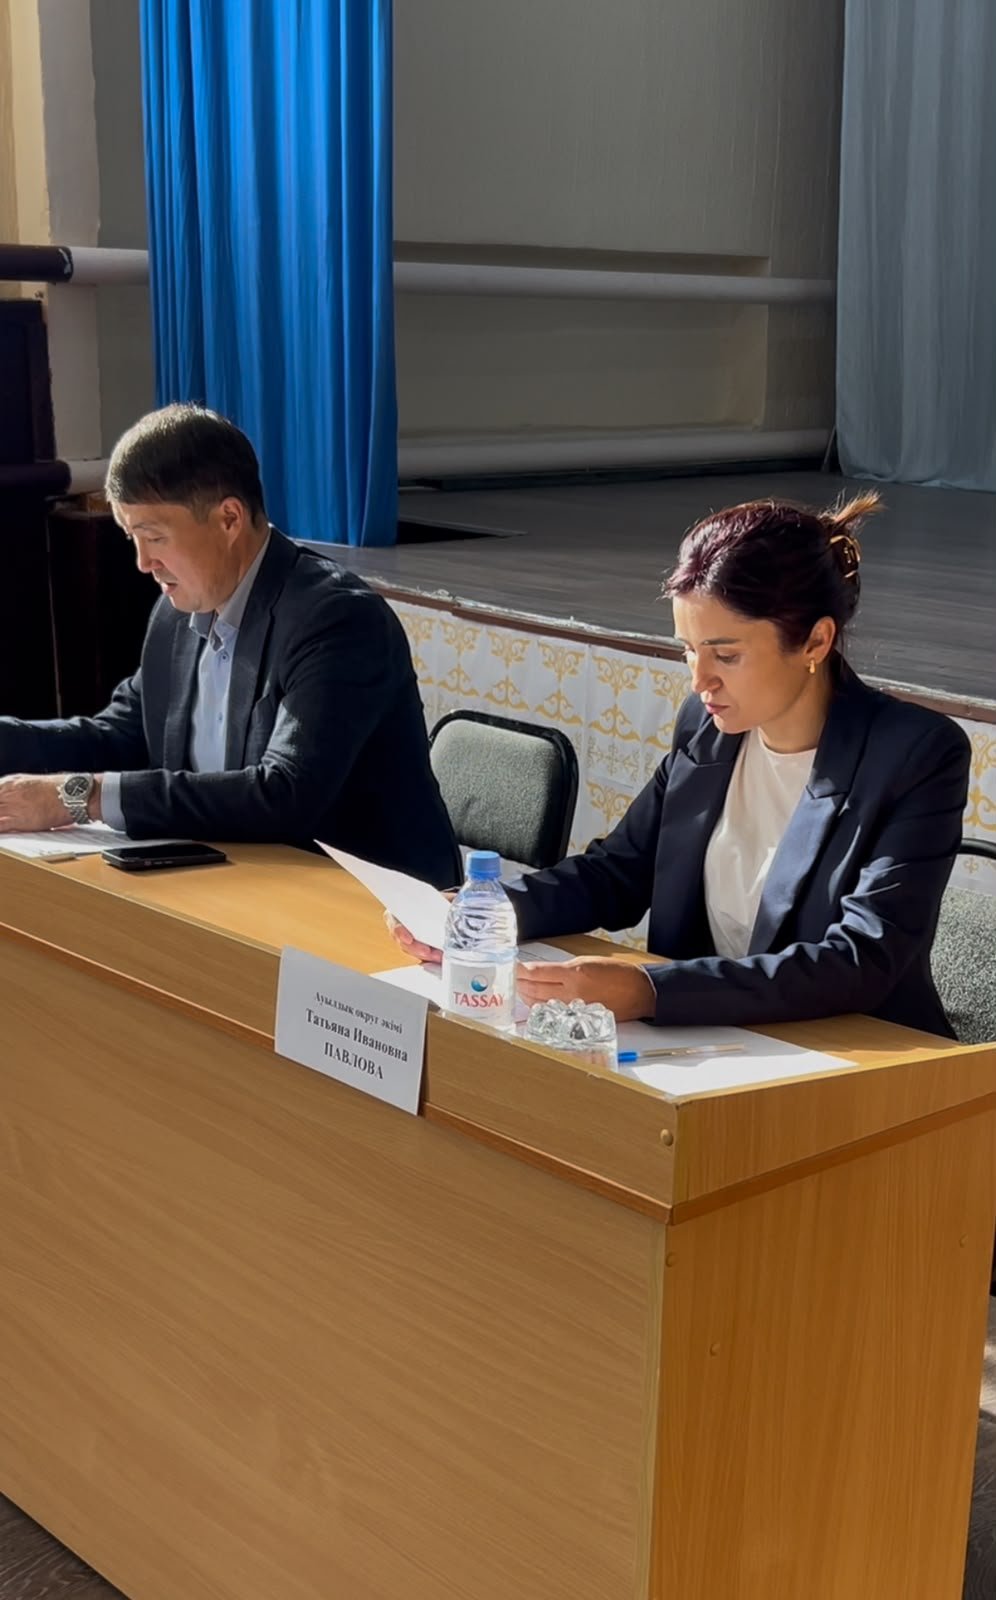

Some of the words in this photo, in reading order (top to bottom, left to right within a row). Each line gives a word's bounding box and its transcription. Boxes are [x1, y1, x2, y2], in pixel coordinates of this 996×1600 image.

[453, 992, 505, 1008] TASSAY
[355, 1008, 379, 1026] округ
[306, 1008, 350, 1039] Татьяна
[353, 1027, 408, 1062] Ивановна
[324, 1041, 384, 1080] ПАВЛОВА
